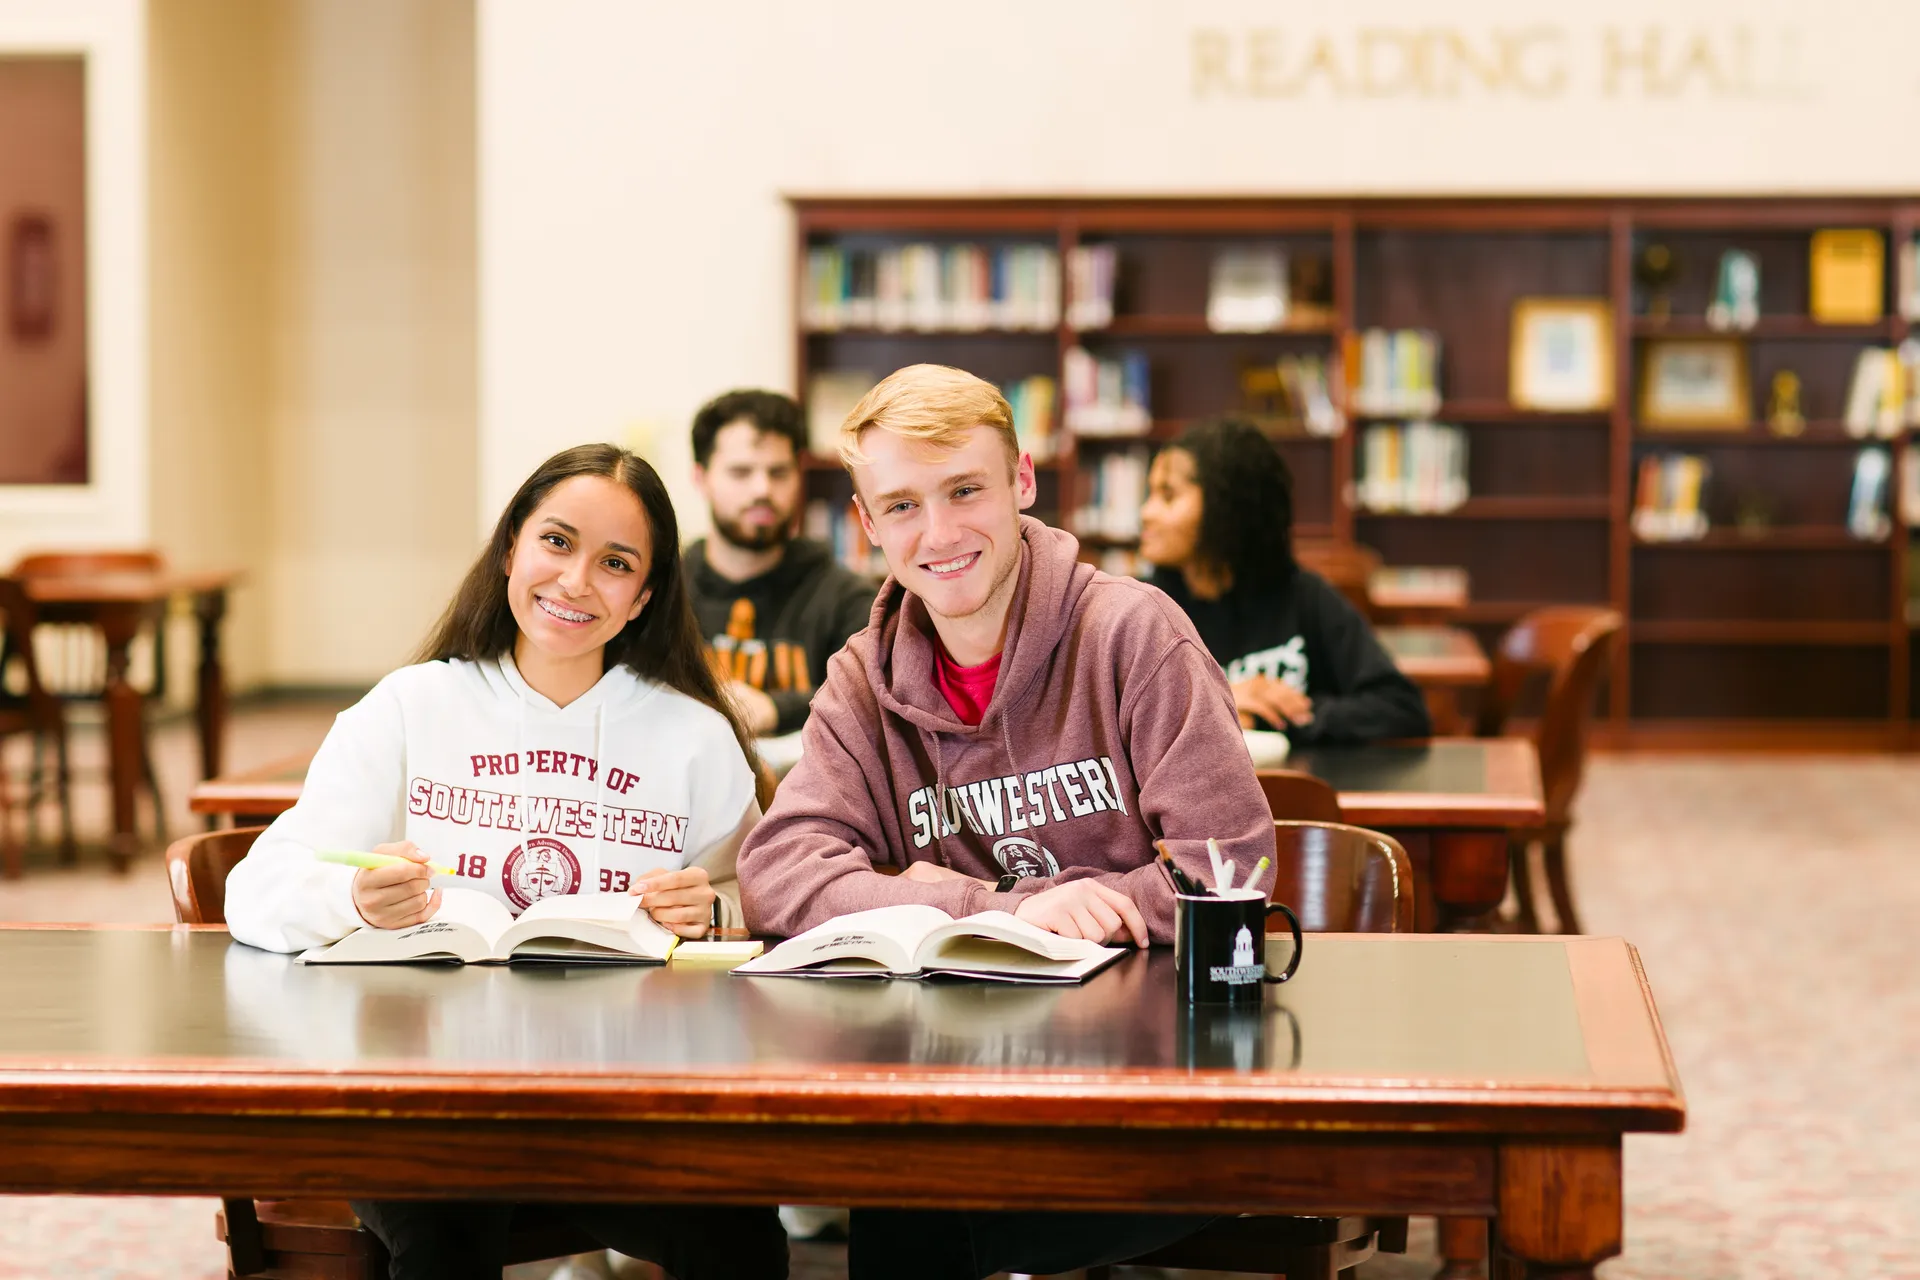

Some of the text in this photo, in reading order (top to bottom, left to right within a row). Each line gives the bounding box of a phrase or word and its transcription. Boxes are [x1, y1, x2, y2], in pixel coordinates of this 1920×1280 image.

[1190, 27, 1568, 100] READING
[409, 777, 689, 853] SOUTHWESTERN
[606, 767, 641, 795] OF
[908, 756, 1130, 850] SOUHWESTER
[456, 853, 631, 893] 18 93
